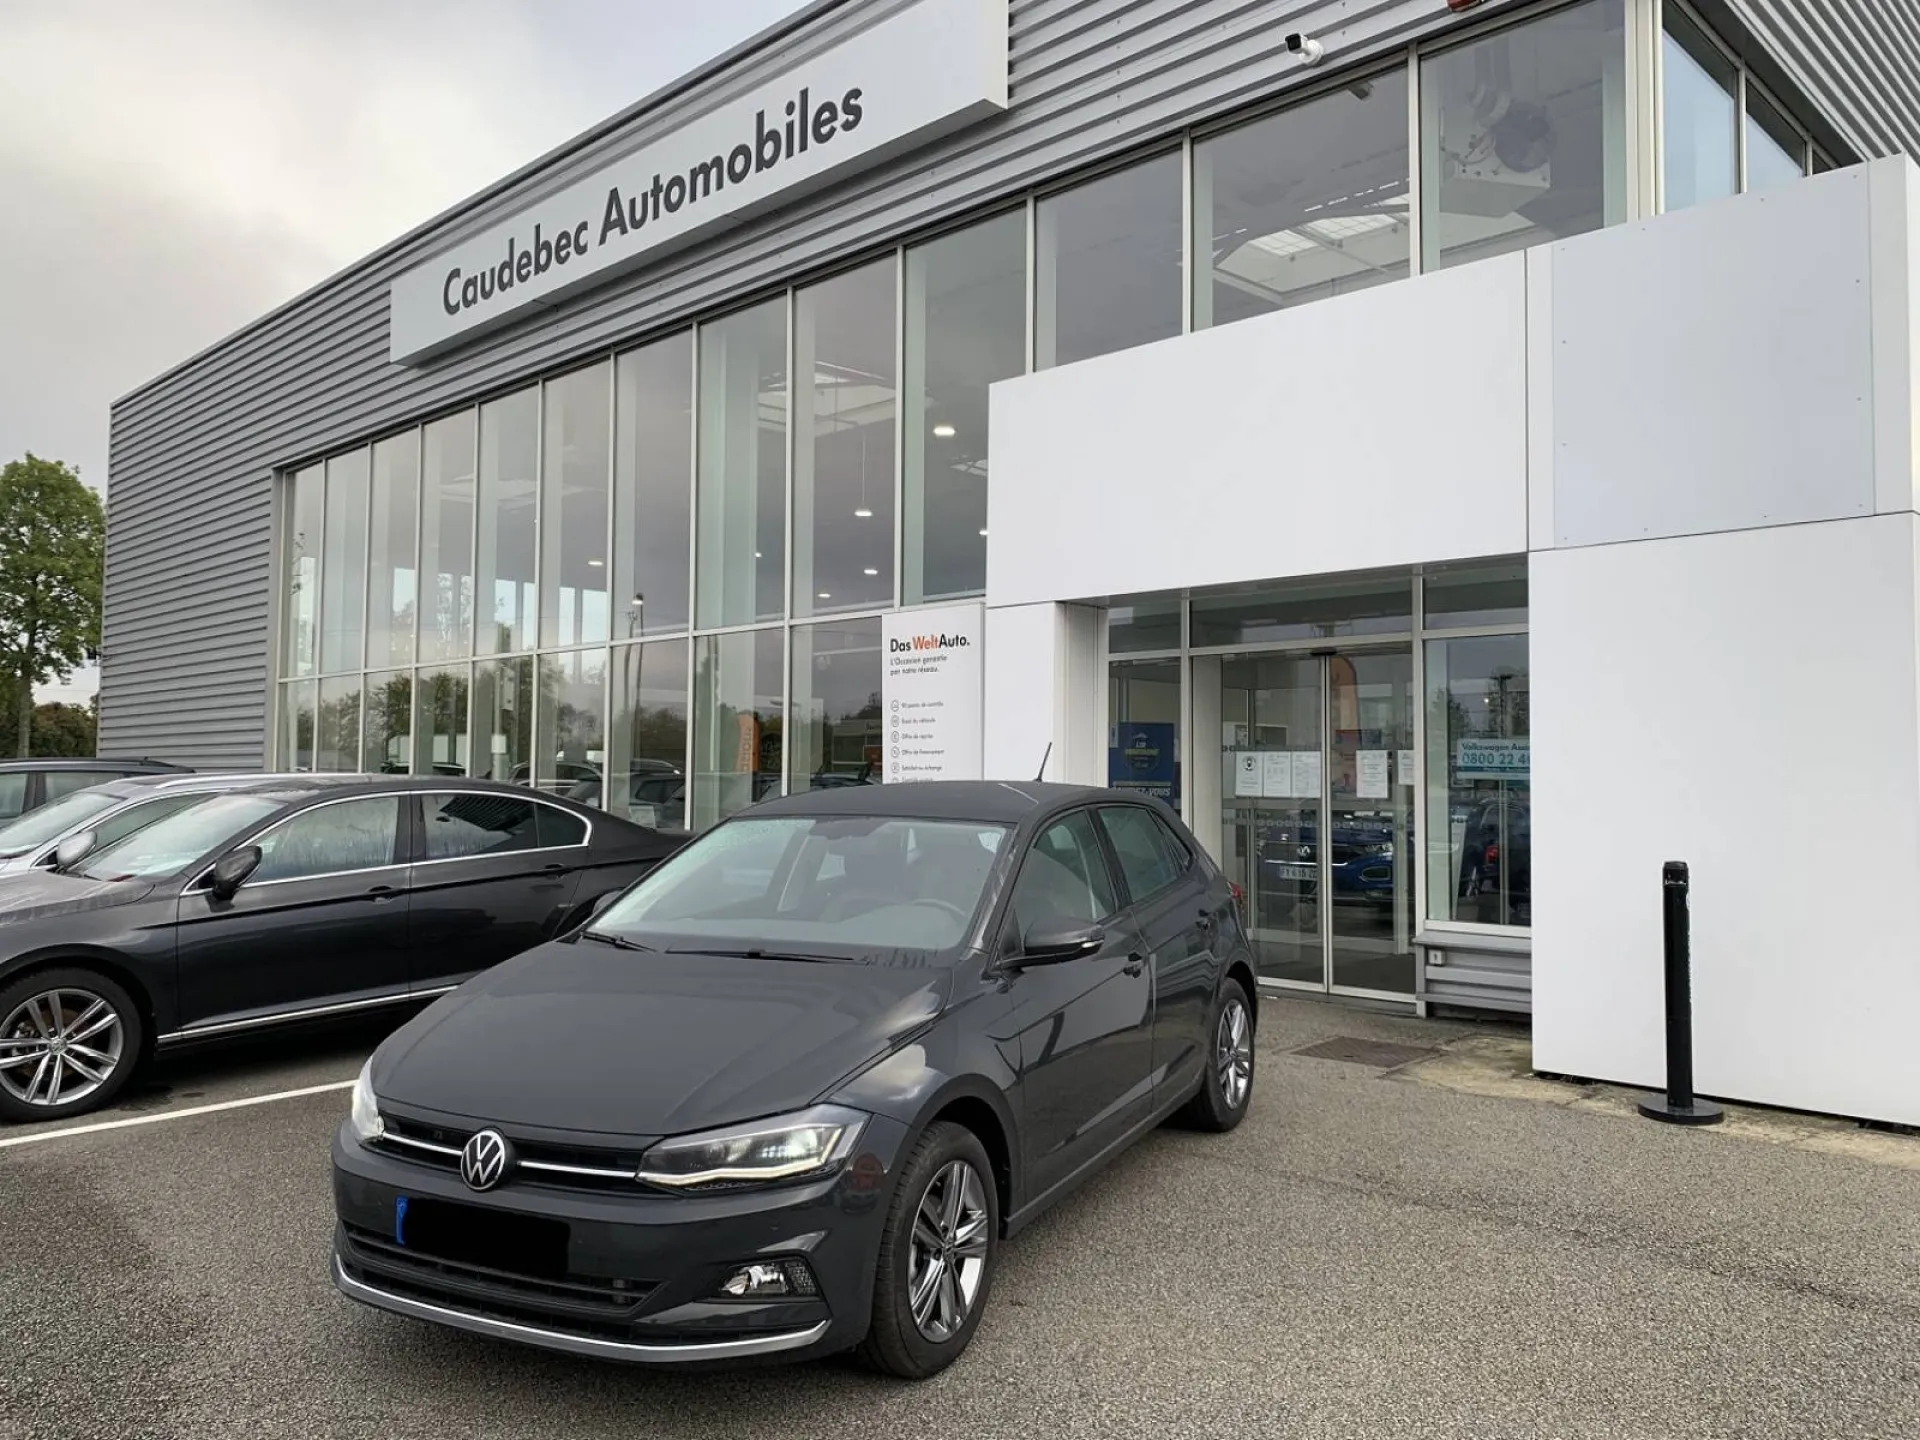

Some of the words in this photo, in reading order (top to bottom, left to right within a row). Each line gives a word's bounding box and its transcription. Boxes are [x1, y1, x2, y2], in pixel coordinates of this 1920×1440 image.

[443, 220, 589, 315] Caudebec
[598, 87, 863, 246] Automobiles
[890, 638, 911, 652] Das
[1462, 742, 1509, 752] Volkswagen
[1463, 753, 1495, 765] 0800
[1499, 753, 1514, 765] 22
